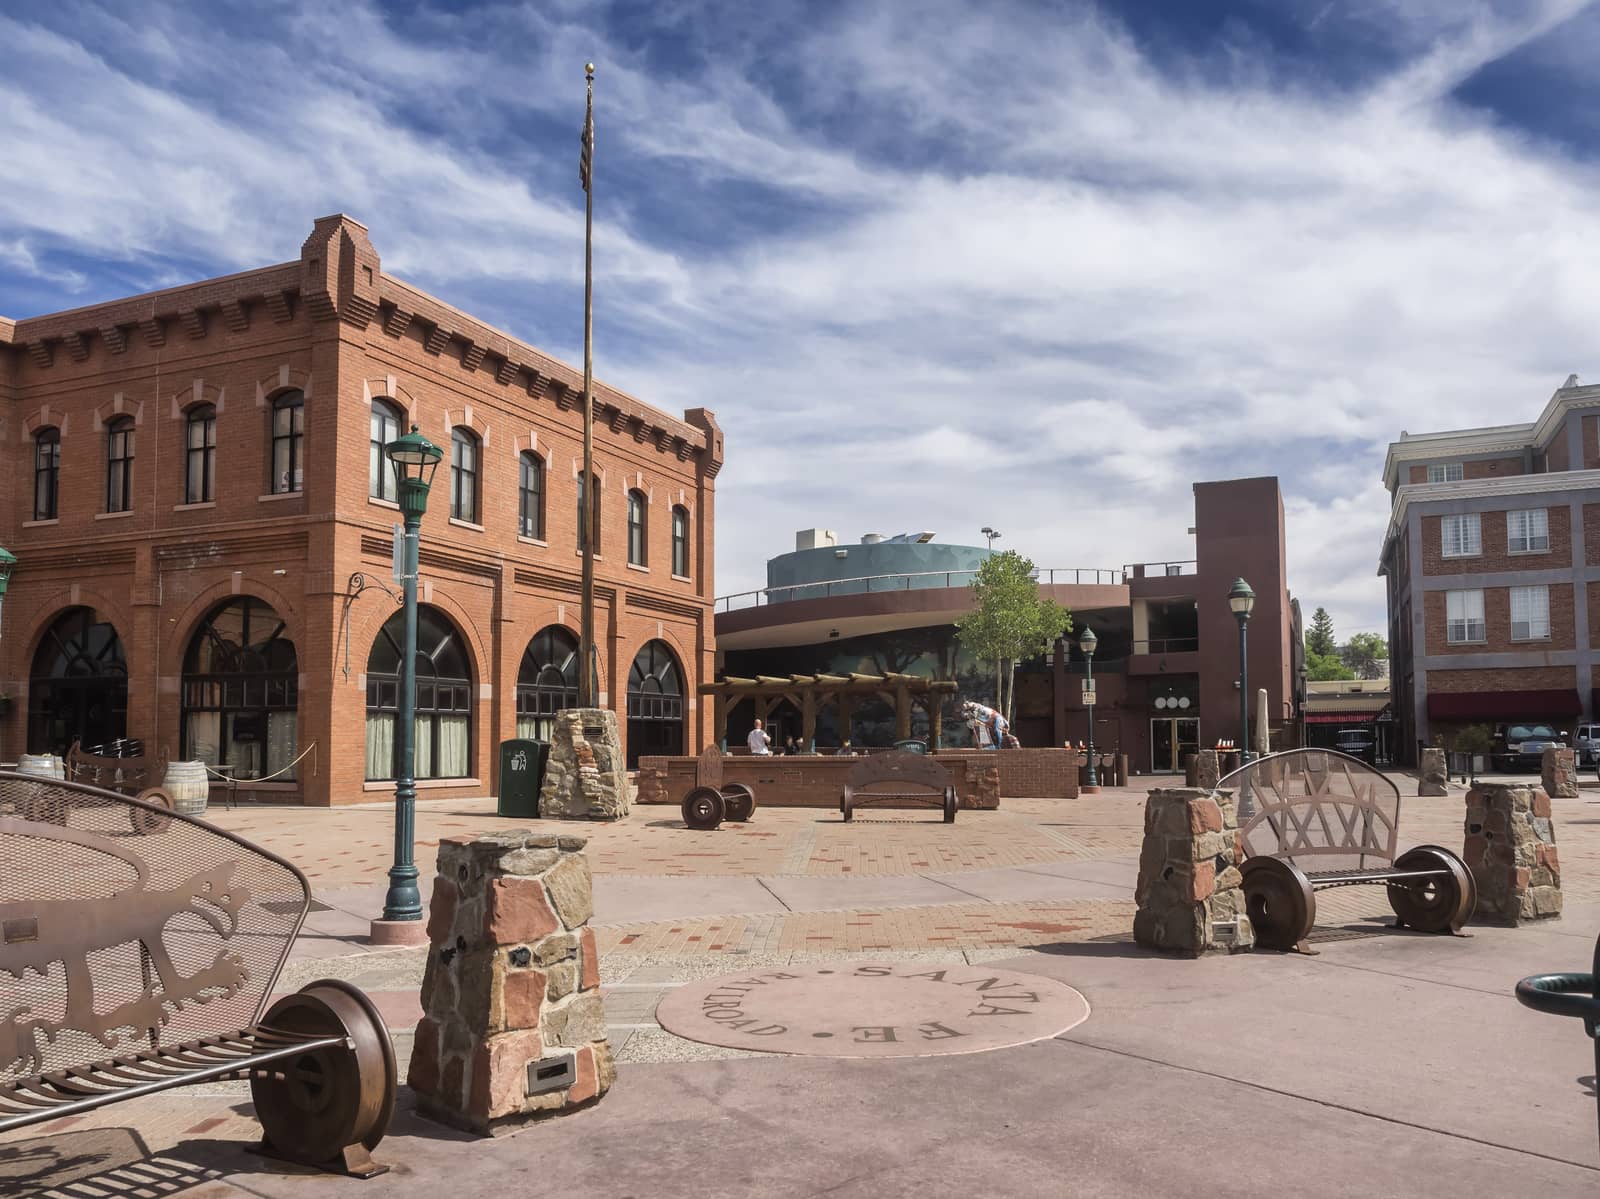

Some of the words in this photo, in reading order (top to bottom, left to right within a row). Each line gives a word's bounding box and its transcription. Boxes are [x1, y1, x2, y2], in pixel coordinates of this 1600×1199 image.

[702, 972, 803, 1036] RAILROAD
[853, 966, 1041, 1017] SANTA
[850, 1021, 973, 1042] FE
